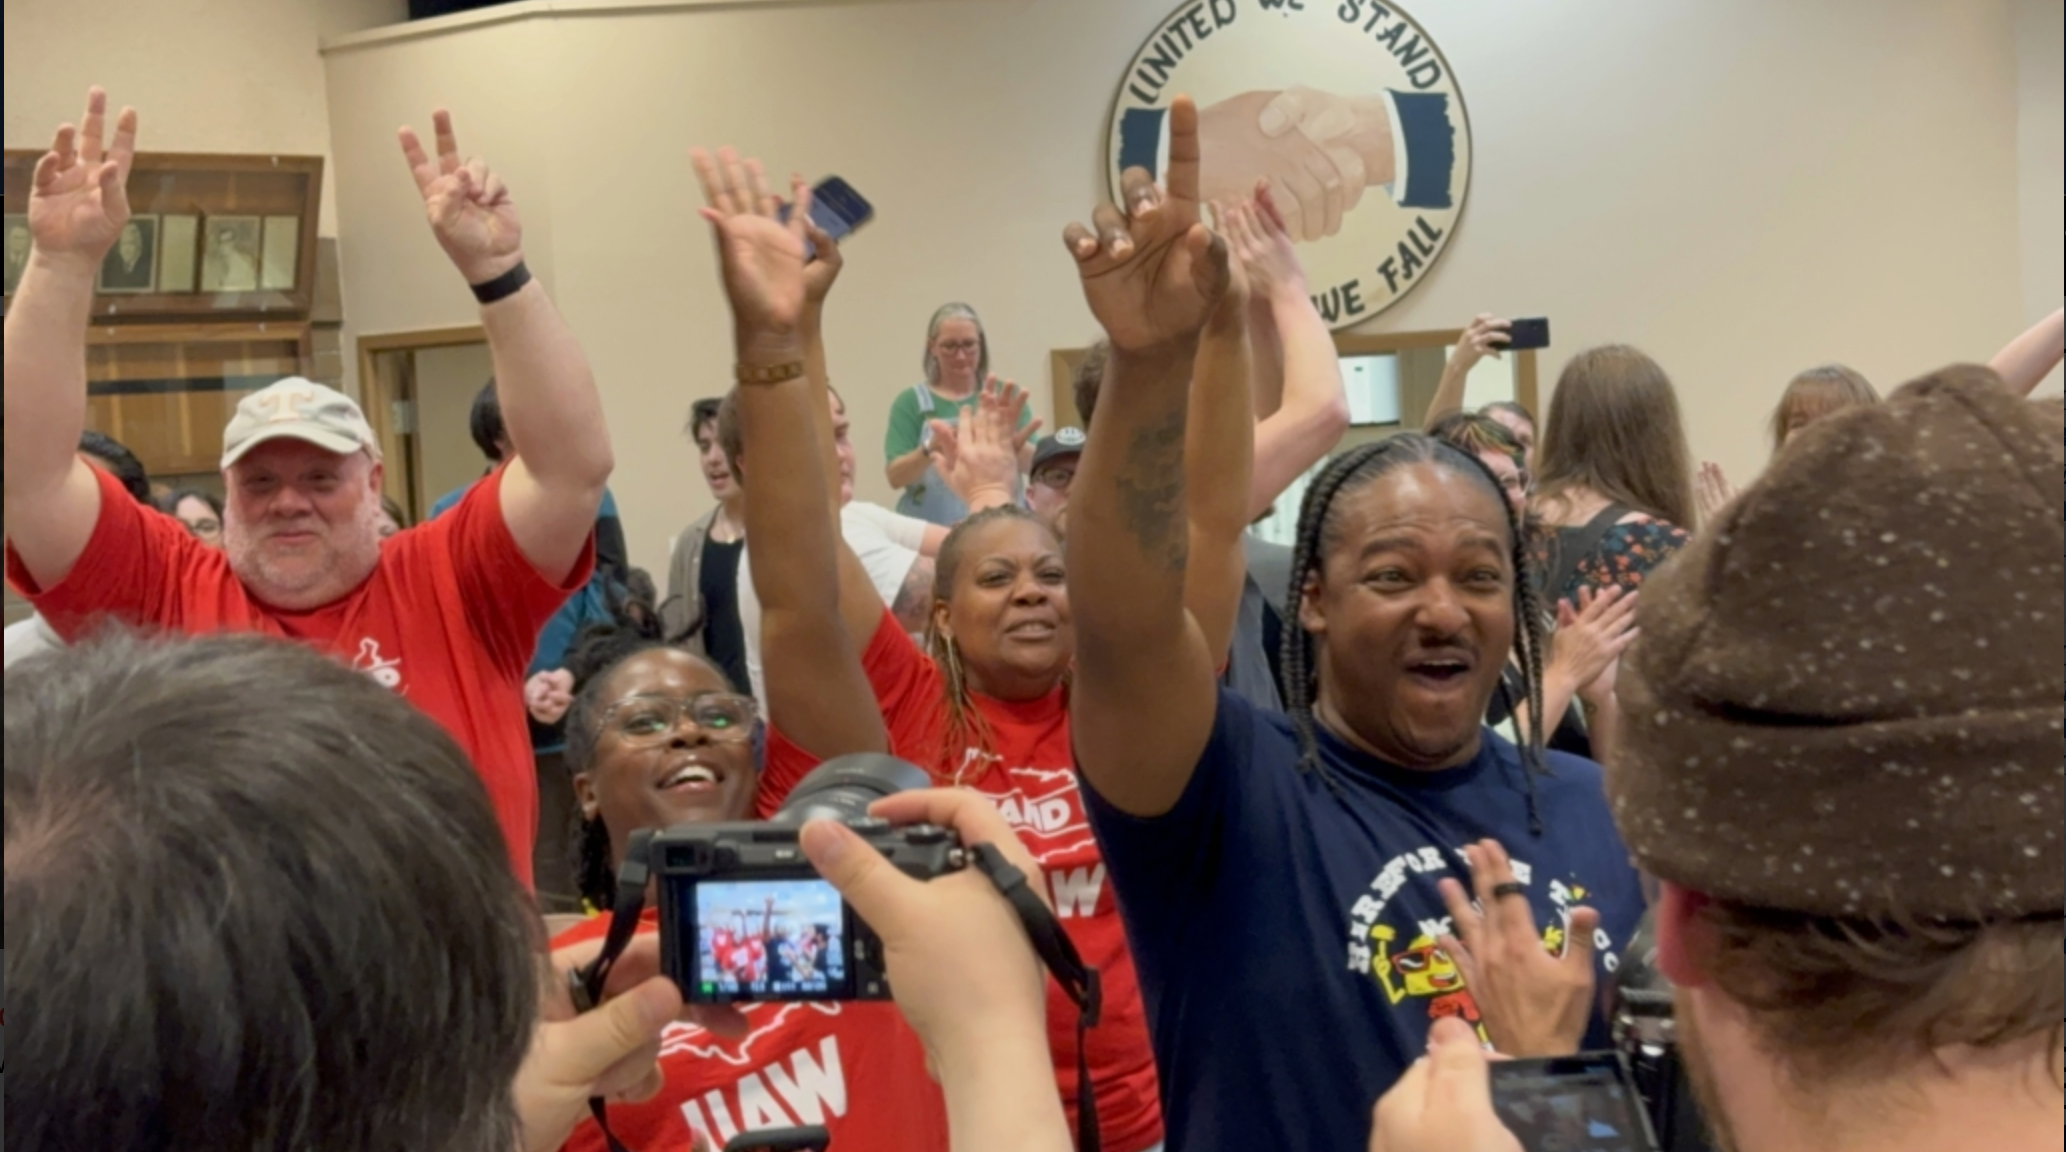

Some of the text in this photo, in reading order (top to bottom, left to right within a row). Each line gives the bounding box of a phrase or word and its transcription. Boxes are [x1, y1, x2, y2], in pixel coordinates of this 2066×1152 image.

[1128, 0, 1442, 105] UNITED STAND
[1311, 215, 1443, 323] WE FALL
[992, 797, 1071, 832] AND
